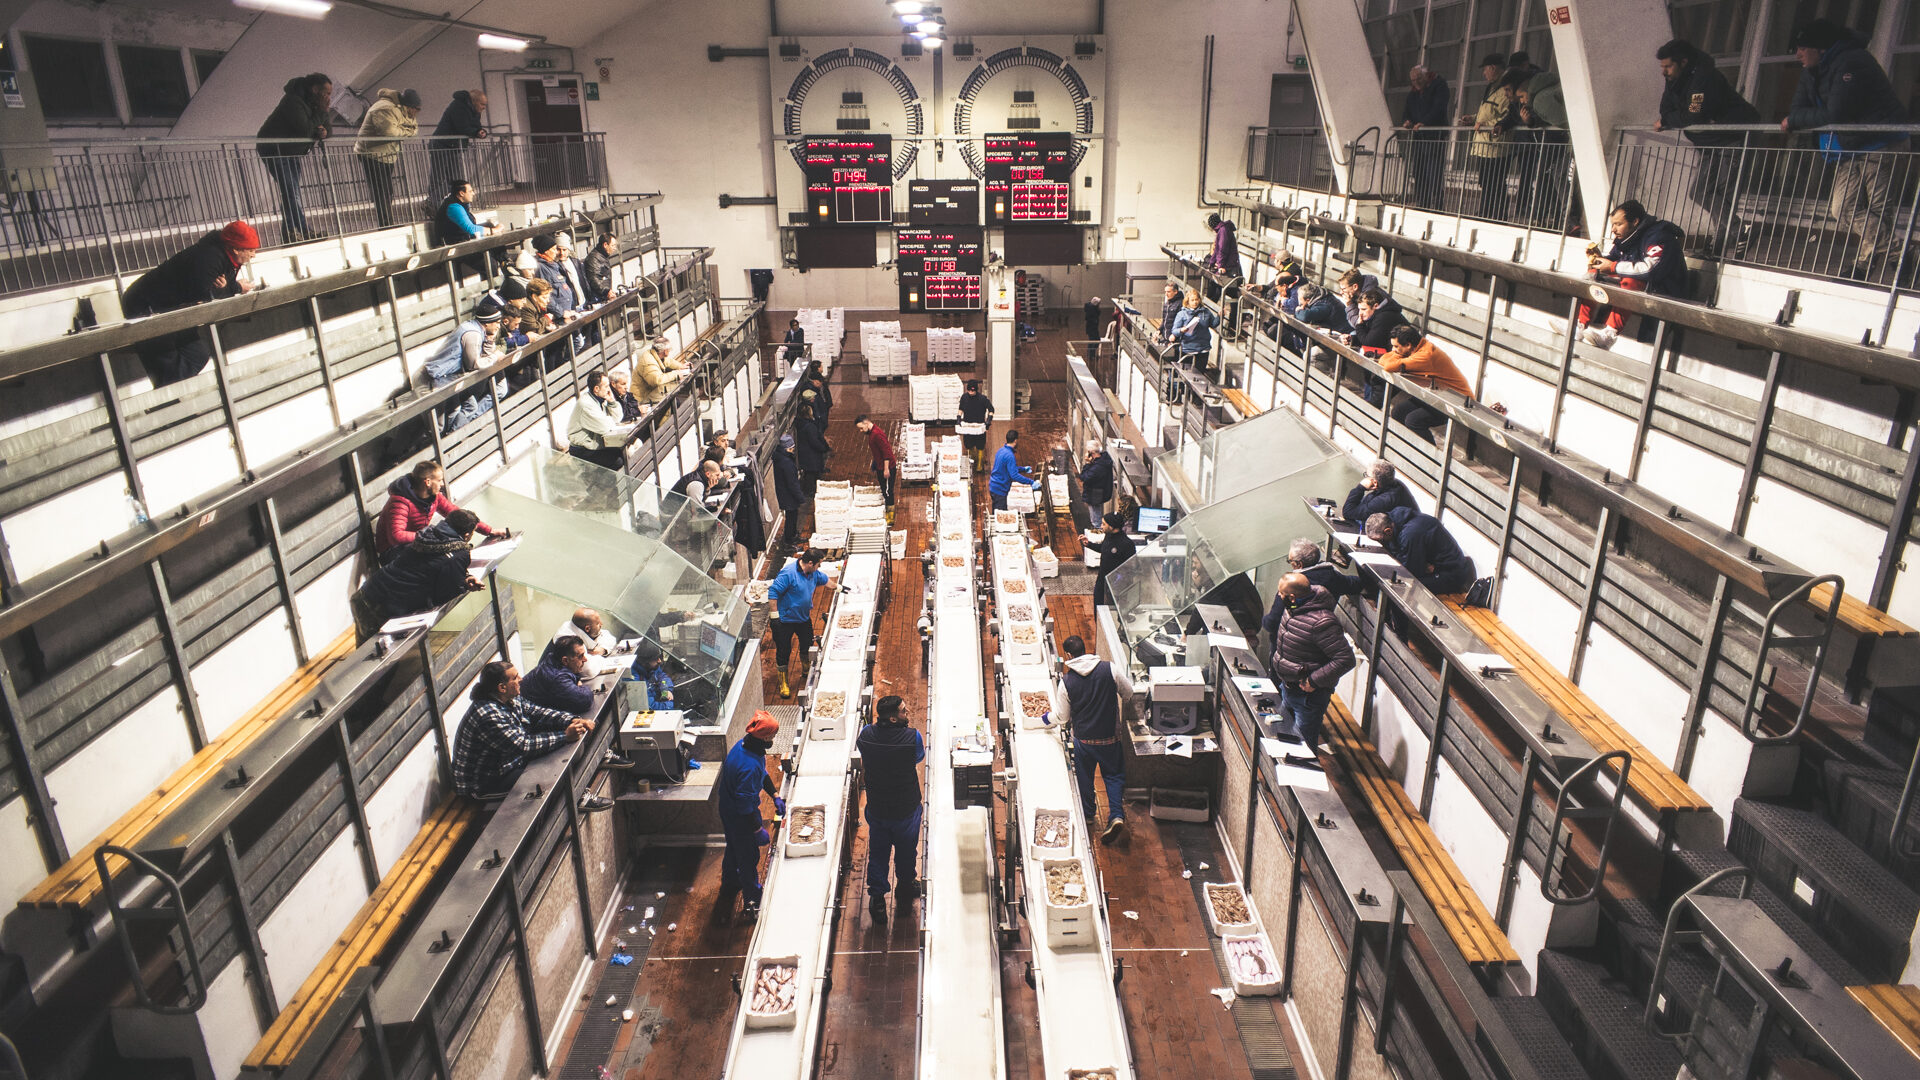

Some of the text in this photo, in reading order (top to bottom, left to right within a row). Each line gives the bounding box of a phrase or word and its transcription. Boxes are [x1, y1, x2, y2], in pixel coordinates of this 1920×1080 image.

[833, 172, 866, 182] 01494
[1011, 170, 1044, 179] 00758
[924, 262, 956, 271] 01198
